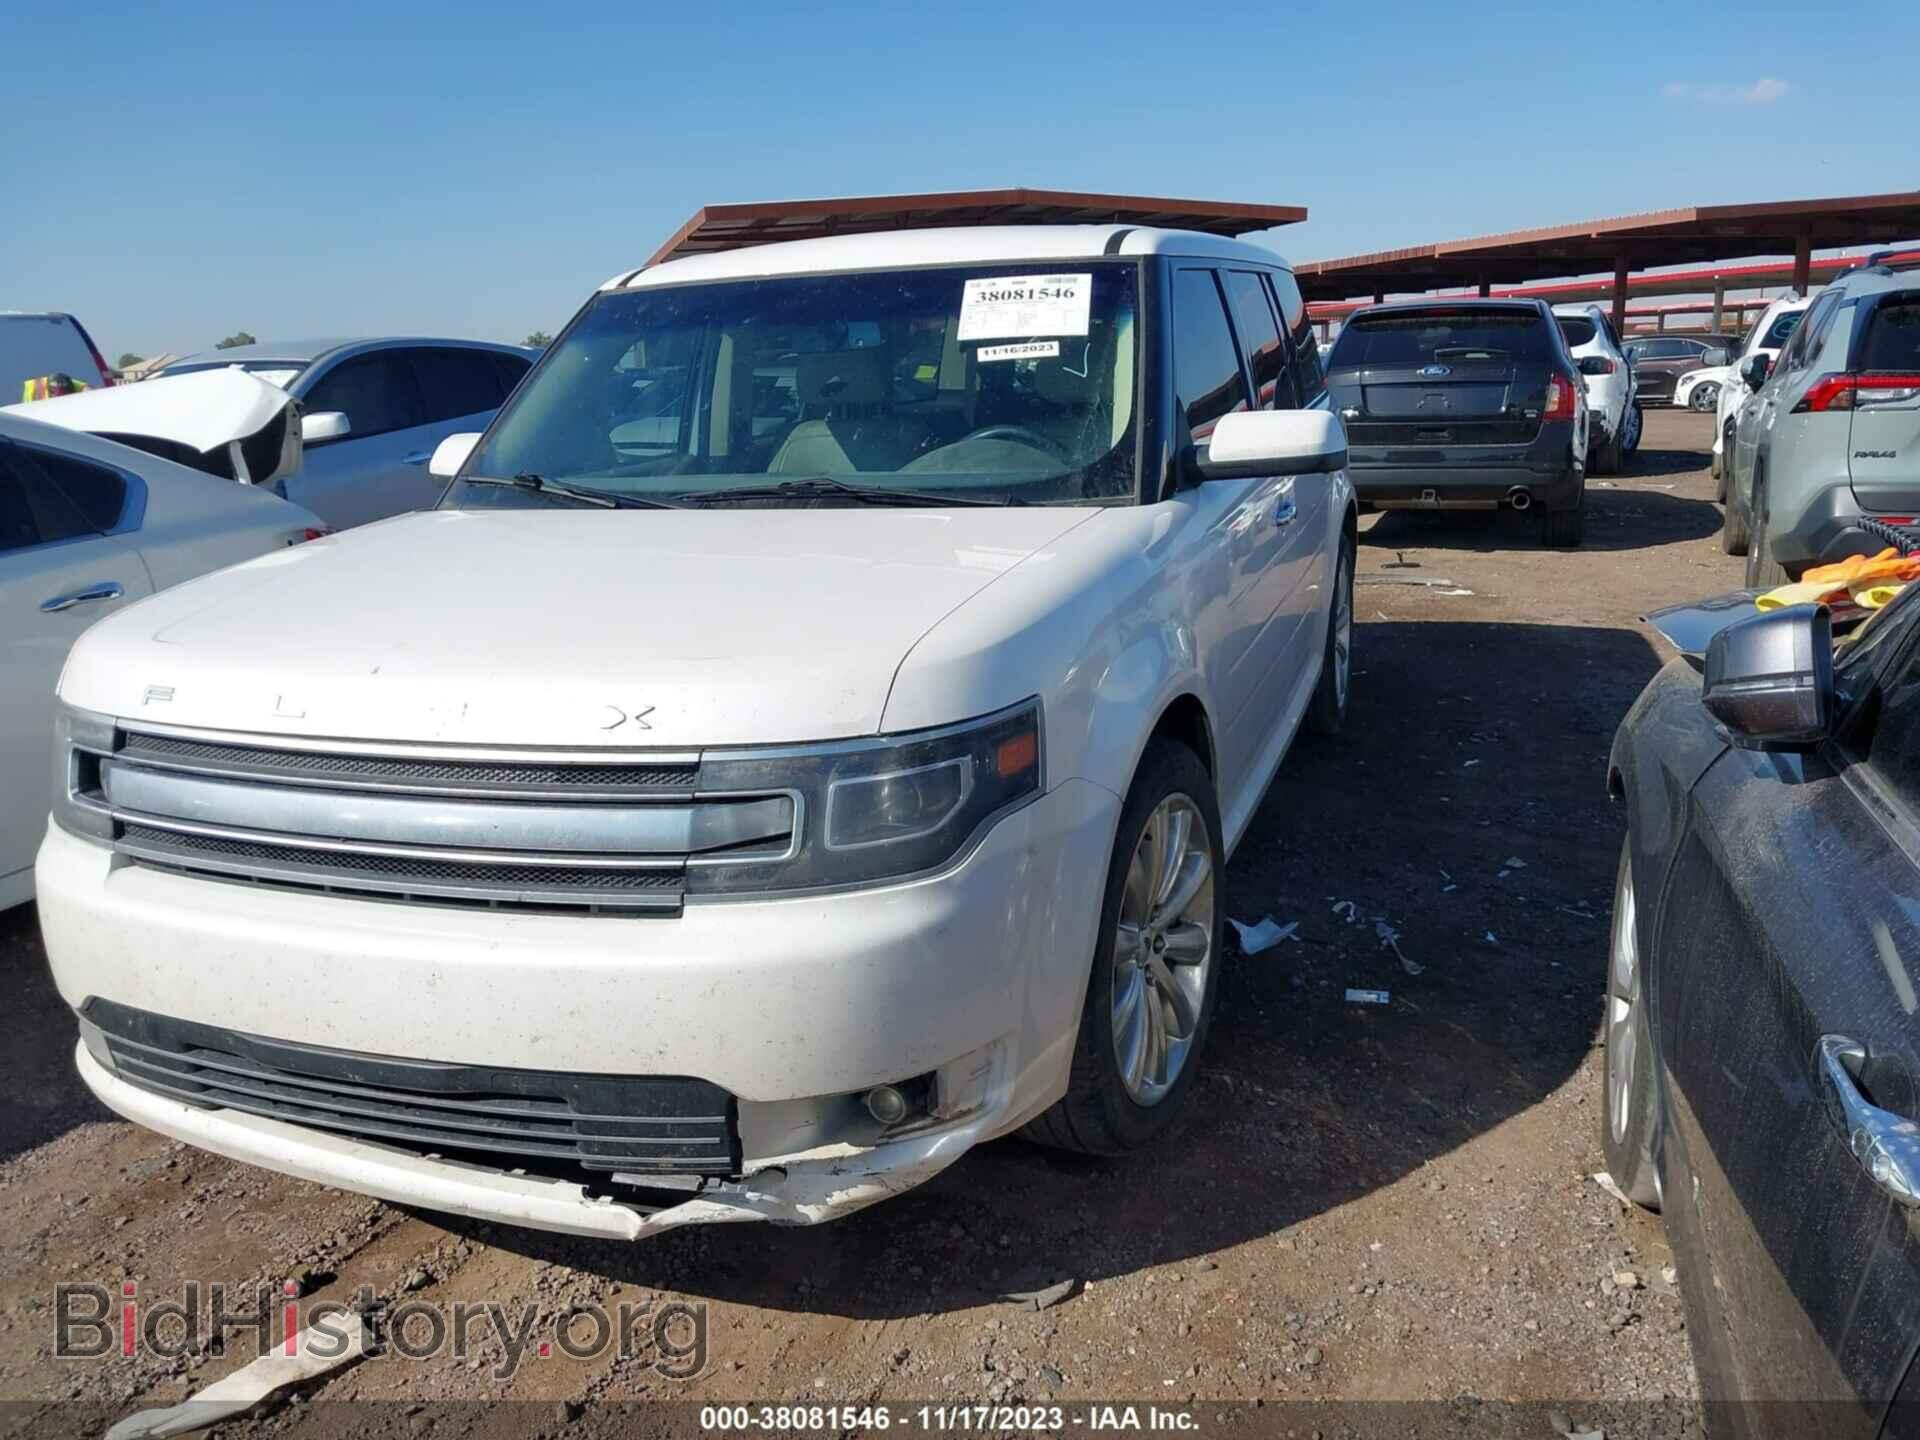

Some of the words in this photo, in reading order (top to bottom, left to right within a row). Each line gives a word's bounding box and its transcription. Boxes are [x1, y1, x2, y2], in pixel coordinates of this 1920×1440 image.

[976, 287, 1075, 303] 38081546
[983, 344, 1054, 357] 11/16/2023
[143, 684, 656, 730] FLX
